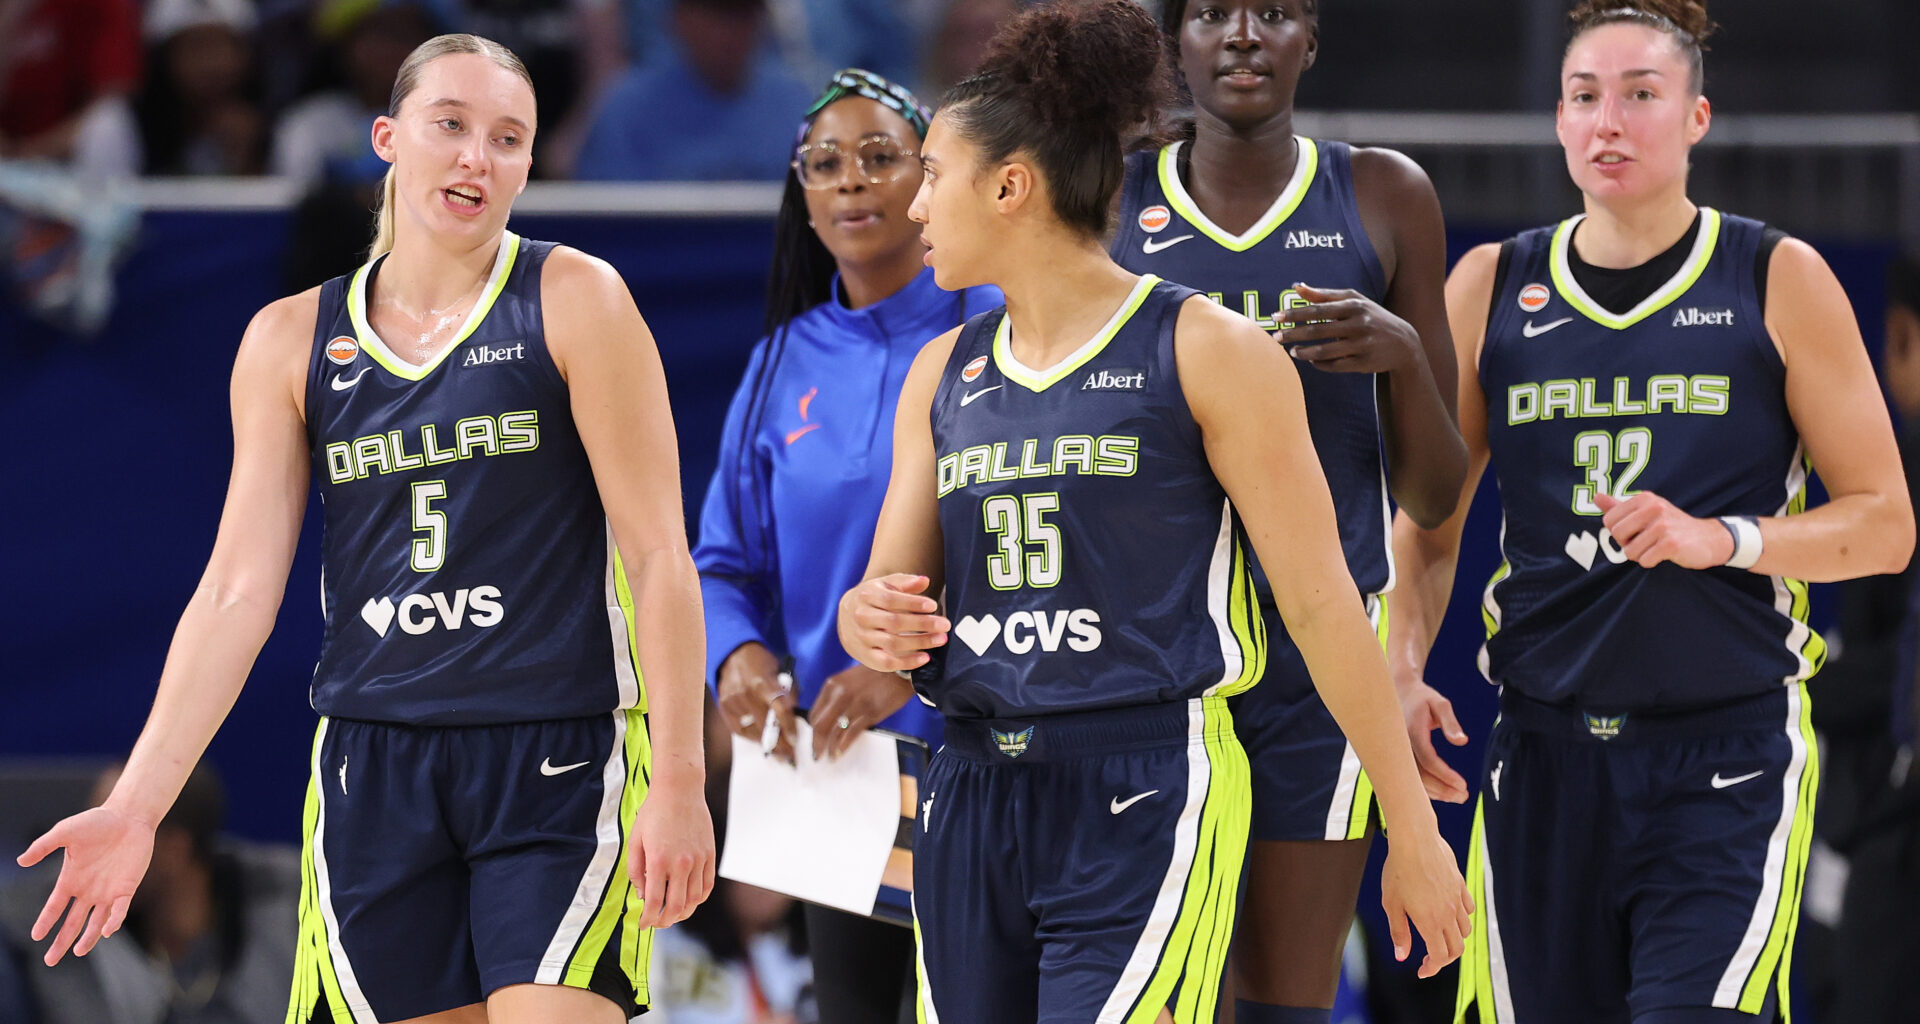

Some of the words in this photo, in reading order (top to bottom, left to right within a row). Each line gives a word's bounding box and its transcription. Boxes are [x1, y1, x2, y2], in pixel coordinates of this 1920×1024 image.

[1284, 230, 1344, 249] Albert
[1672, 308, 1734, 327] Albert
[463, 343, 524, 366] Albert
[1082, 371, 1144, 390] Albert
[1508, 374, 1730, 426] DALLAS
[326, 410, 540, 484] DALLAS
[937, 434, 1139, 499] DALLAS
[1571, 426, 1652, 516] 32
[410, 480, 447, 572] 5
[982, 492, 1062, 590] 35
[398, 585, 504, 635] CVS
[1003, 608, 1102, 655] CVS
